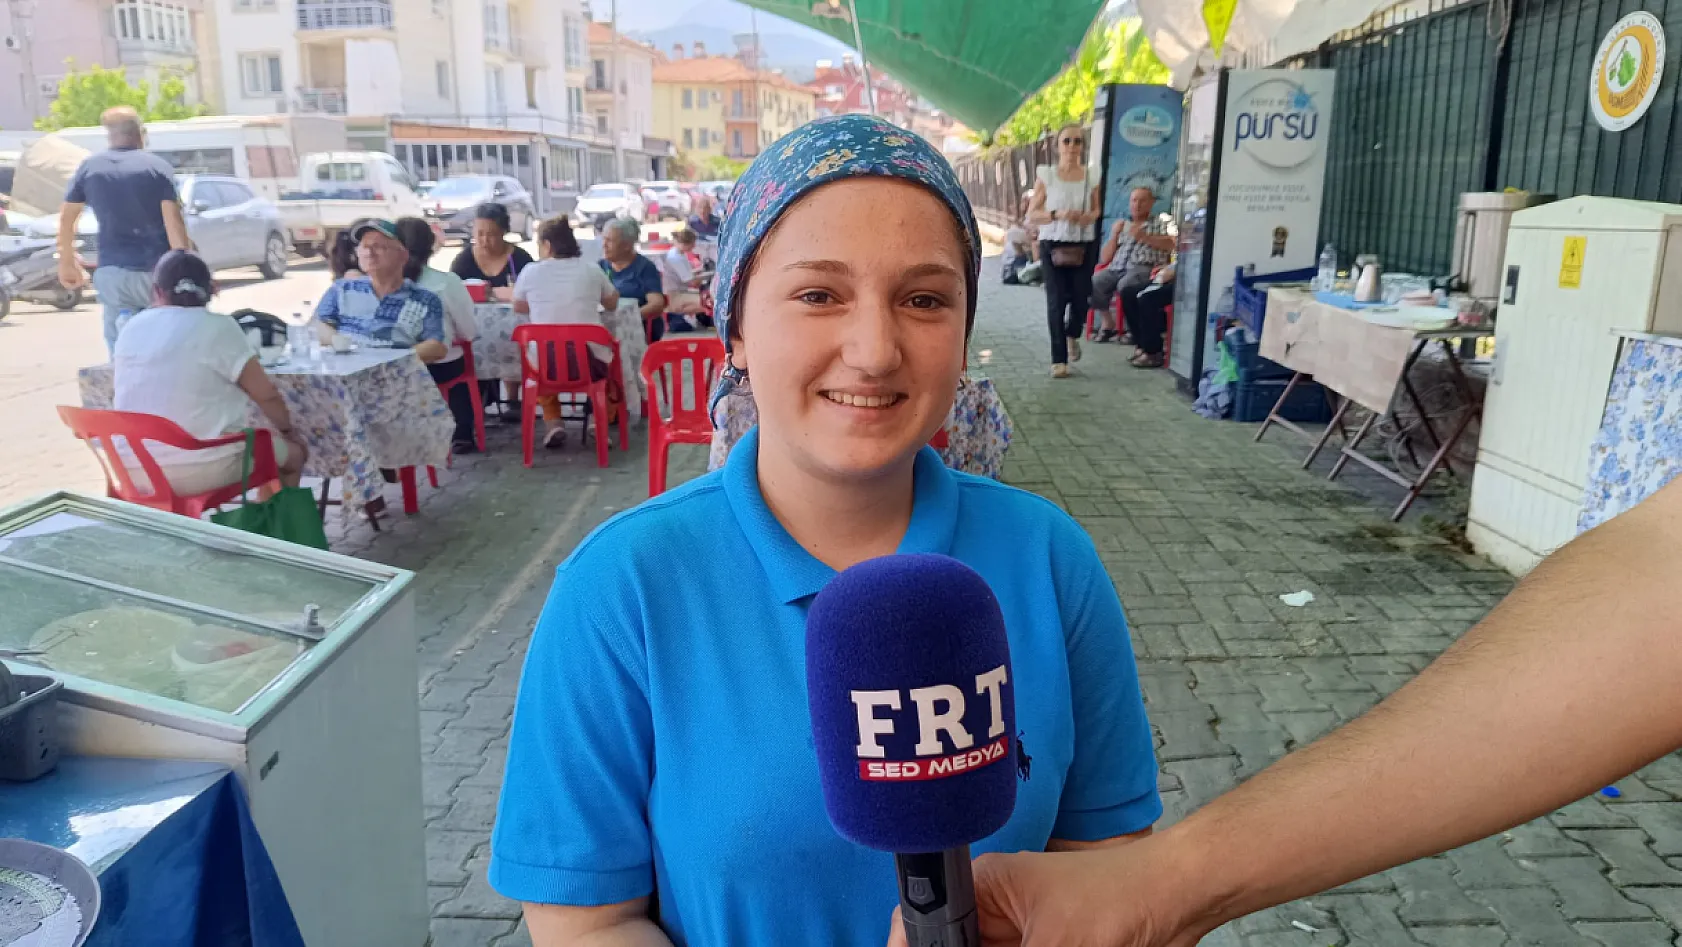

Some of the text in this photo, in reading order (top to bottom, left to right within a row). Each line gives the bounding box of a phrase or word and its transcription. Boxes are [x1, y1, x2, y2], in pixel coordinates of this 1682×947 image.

[1233, 112, 1318, 152] pursu
[851, 664, 1008, 758] FRT
[867, 741, 1005, 777] SED MEDYA
